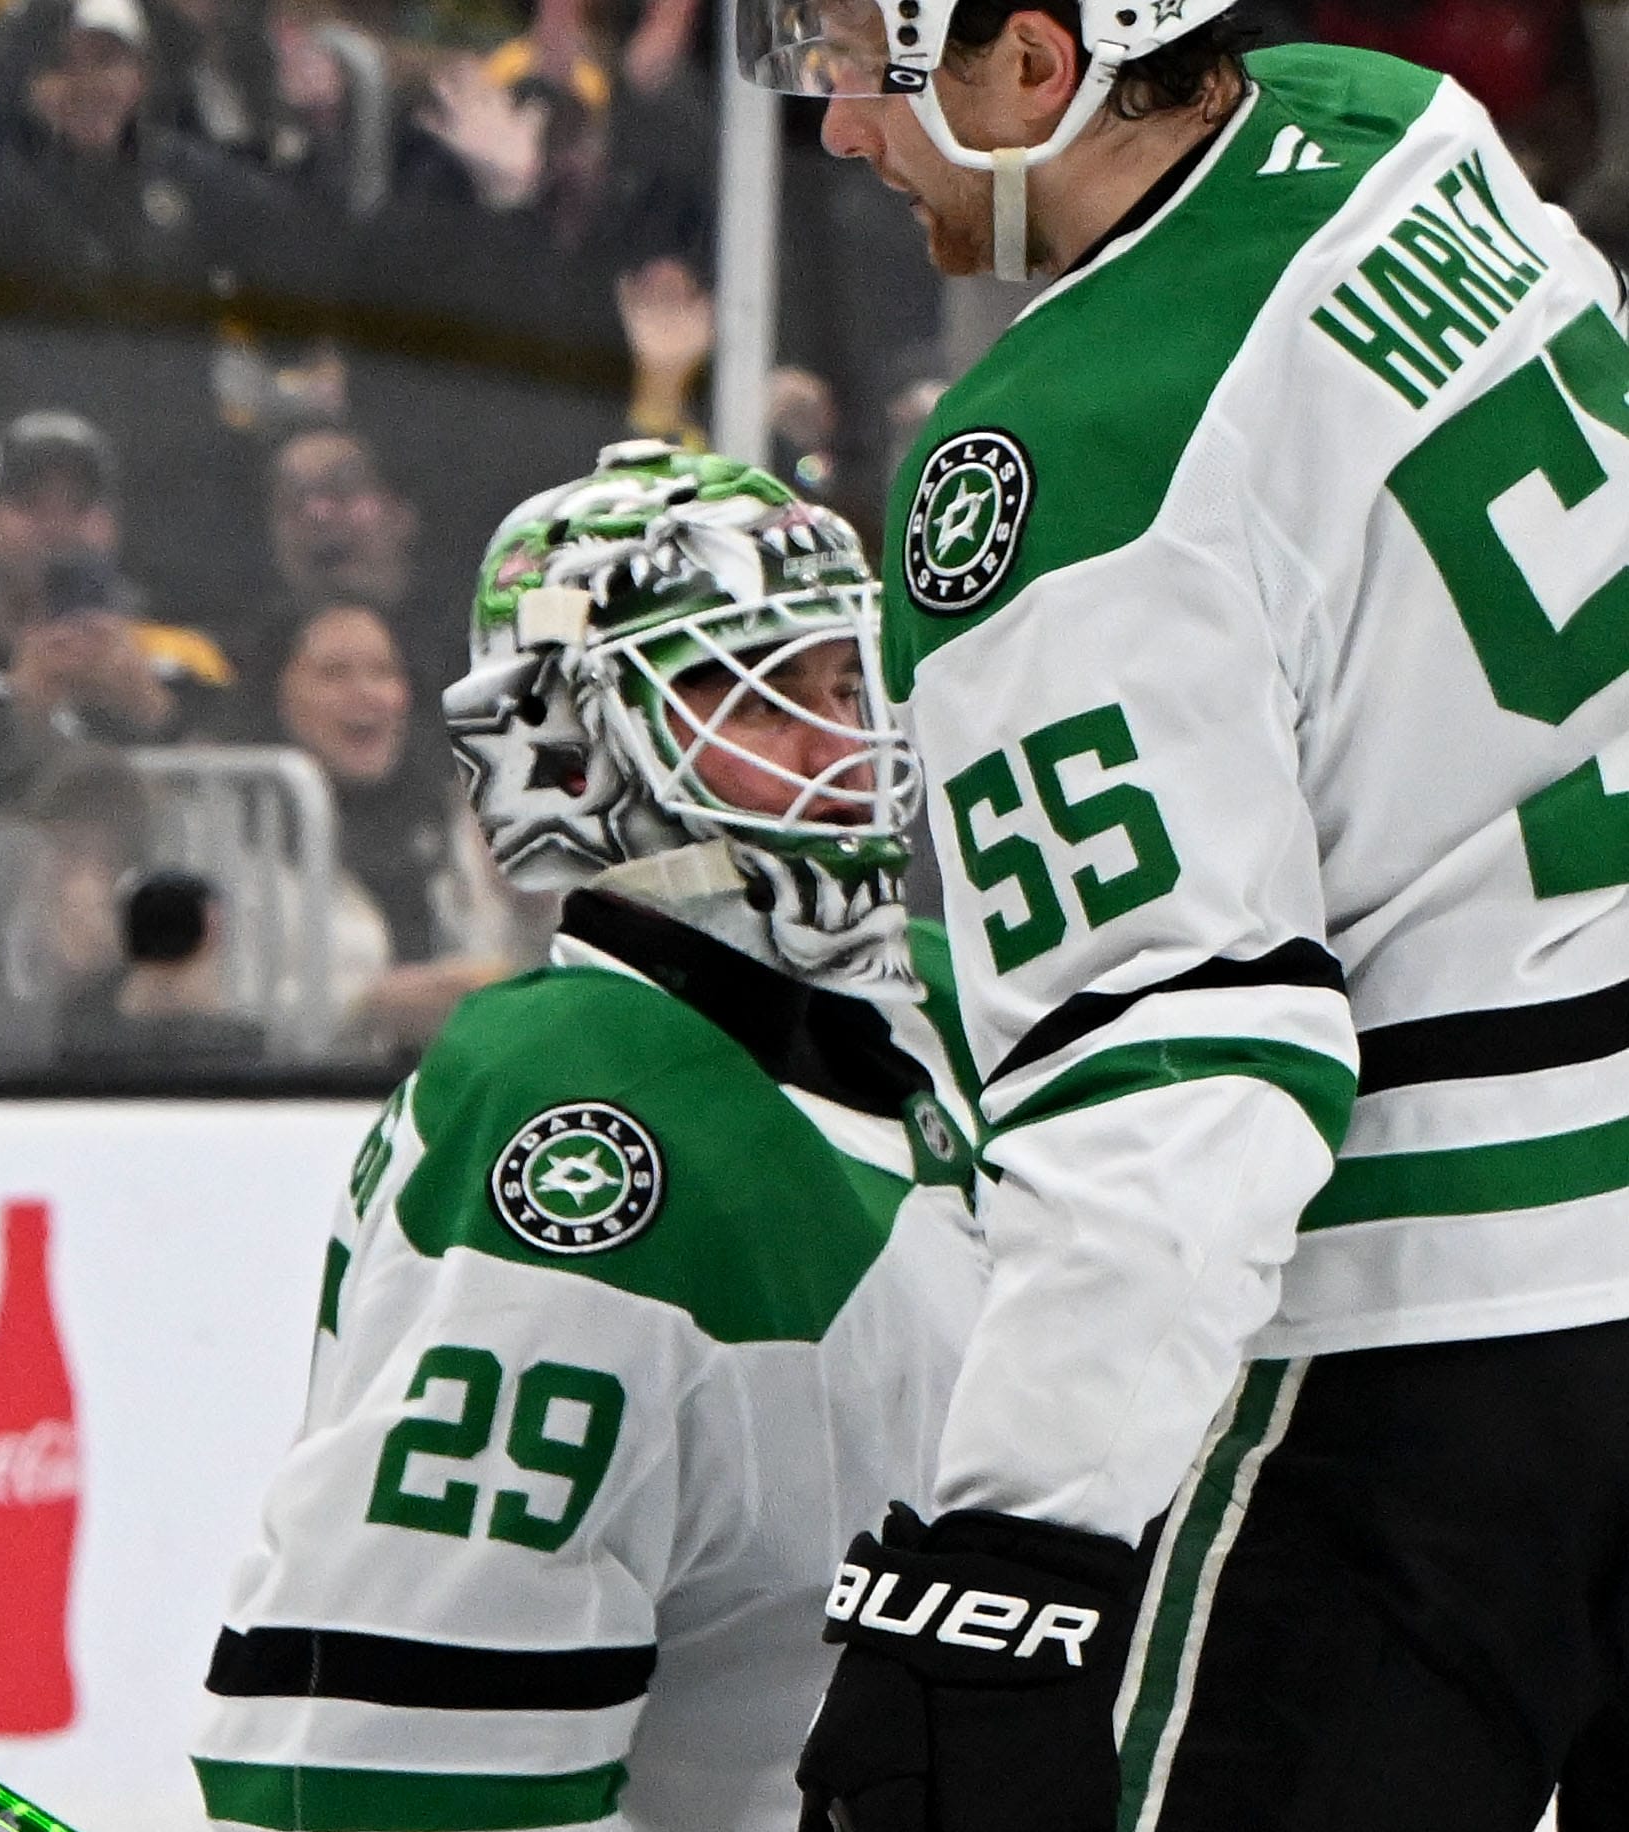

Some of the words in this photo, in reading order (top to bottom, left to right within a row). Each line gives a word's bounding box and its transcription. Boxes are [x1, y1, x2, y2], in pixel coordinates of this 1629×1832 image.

[1310, 149, 1549, 410] HARLEY
[911, 443, 1017, 535] DALLAS
[916, 521, 1011, 598] STARS
[943, 702, 1182, 977] 55
[518, 1111, 653, 1190] DALLAS
[503, 1180, 624, 1243] STARS
[364, 1344, 627, 1553] 29
